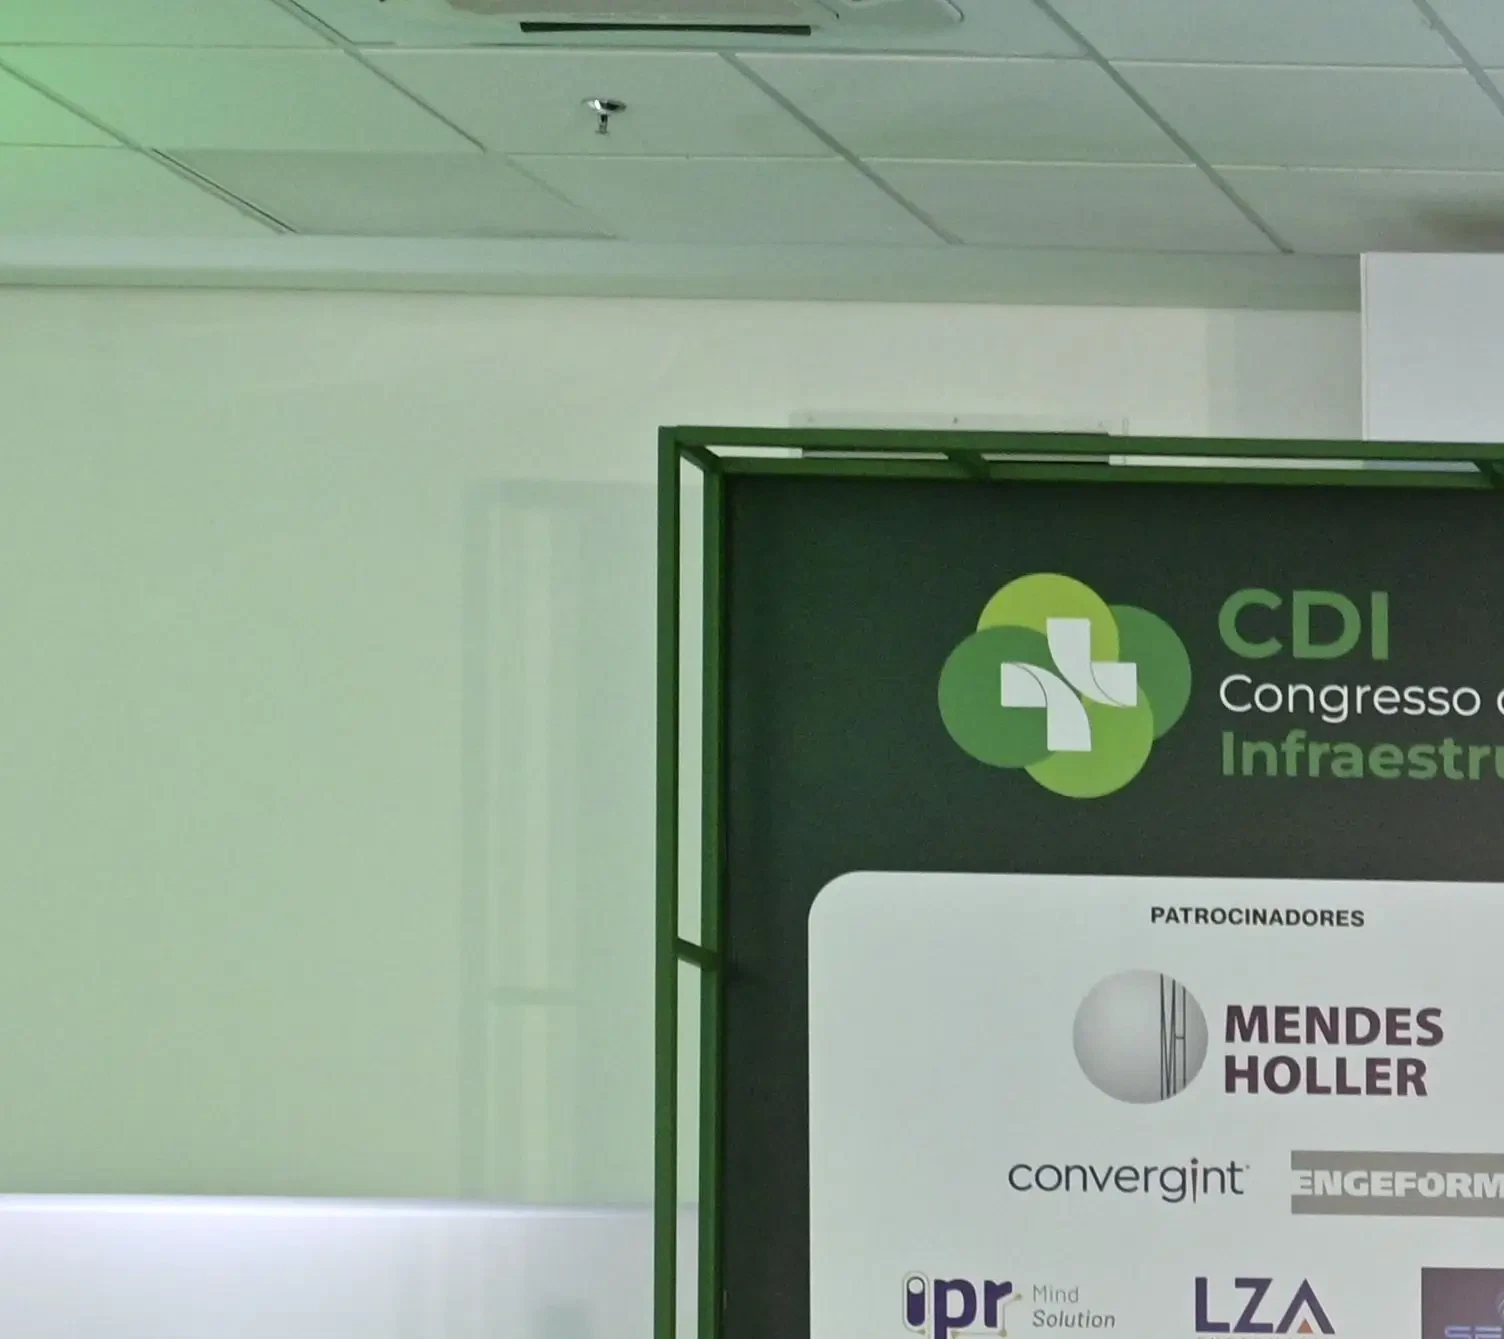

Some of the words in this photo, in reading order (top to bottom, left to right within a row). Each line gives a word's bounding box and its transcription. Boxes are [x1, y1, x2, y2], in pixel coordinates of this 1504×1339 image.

[1218, 588, 1389, 661] CDI
[1219, 673, 1481, 724] Congresso
[1150, 905, 1366, 929] PATROCINADORES
[1225, 1004, 1445, 1047] MENDES
[1224, 1054, 1429, 1098] HOLLER
[1008, 1157, 1245, 1204] convergint
[1032, 1283, 1079, 1304] Mind
[1194, 1276, 1336, 1335] LZA
[1032, 1309, 1116, 1329] Solution
